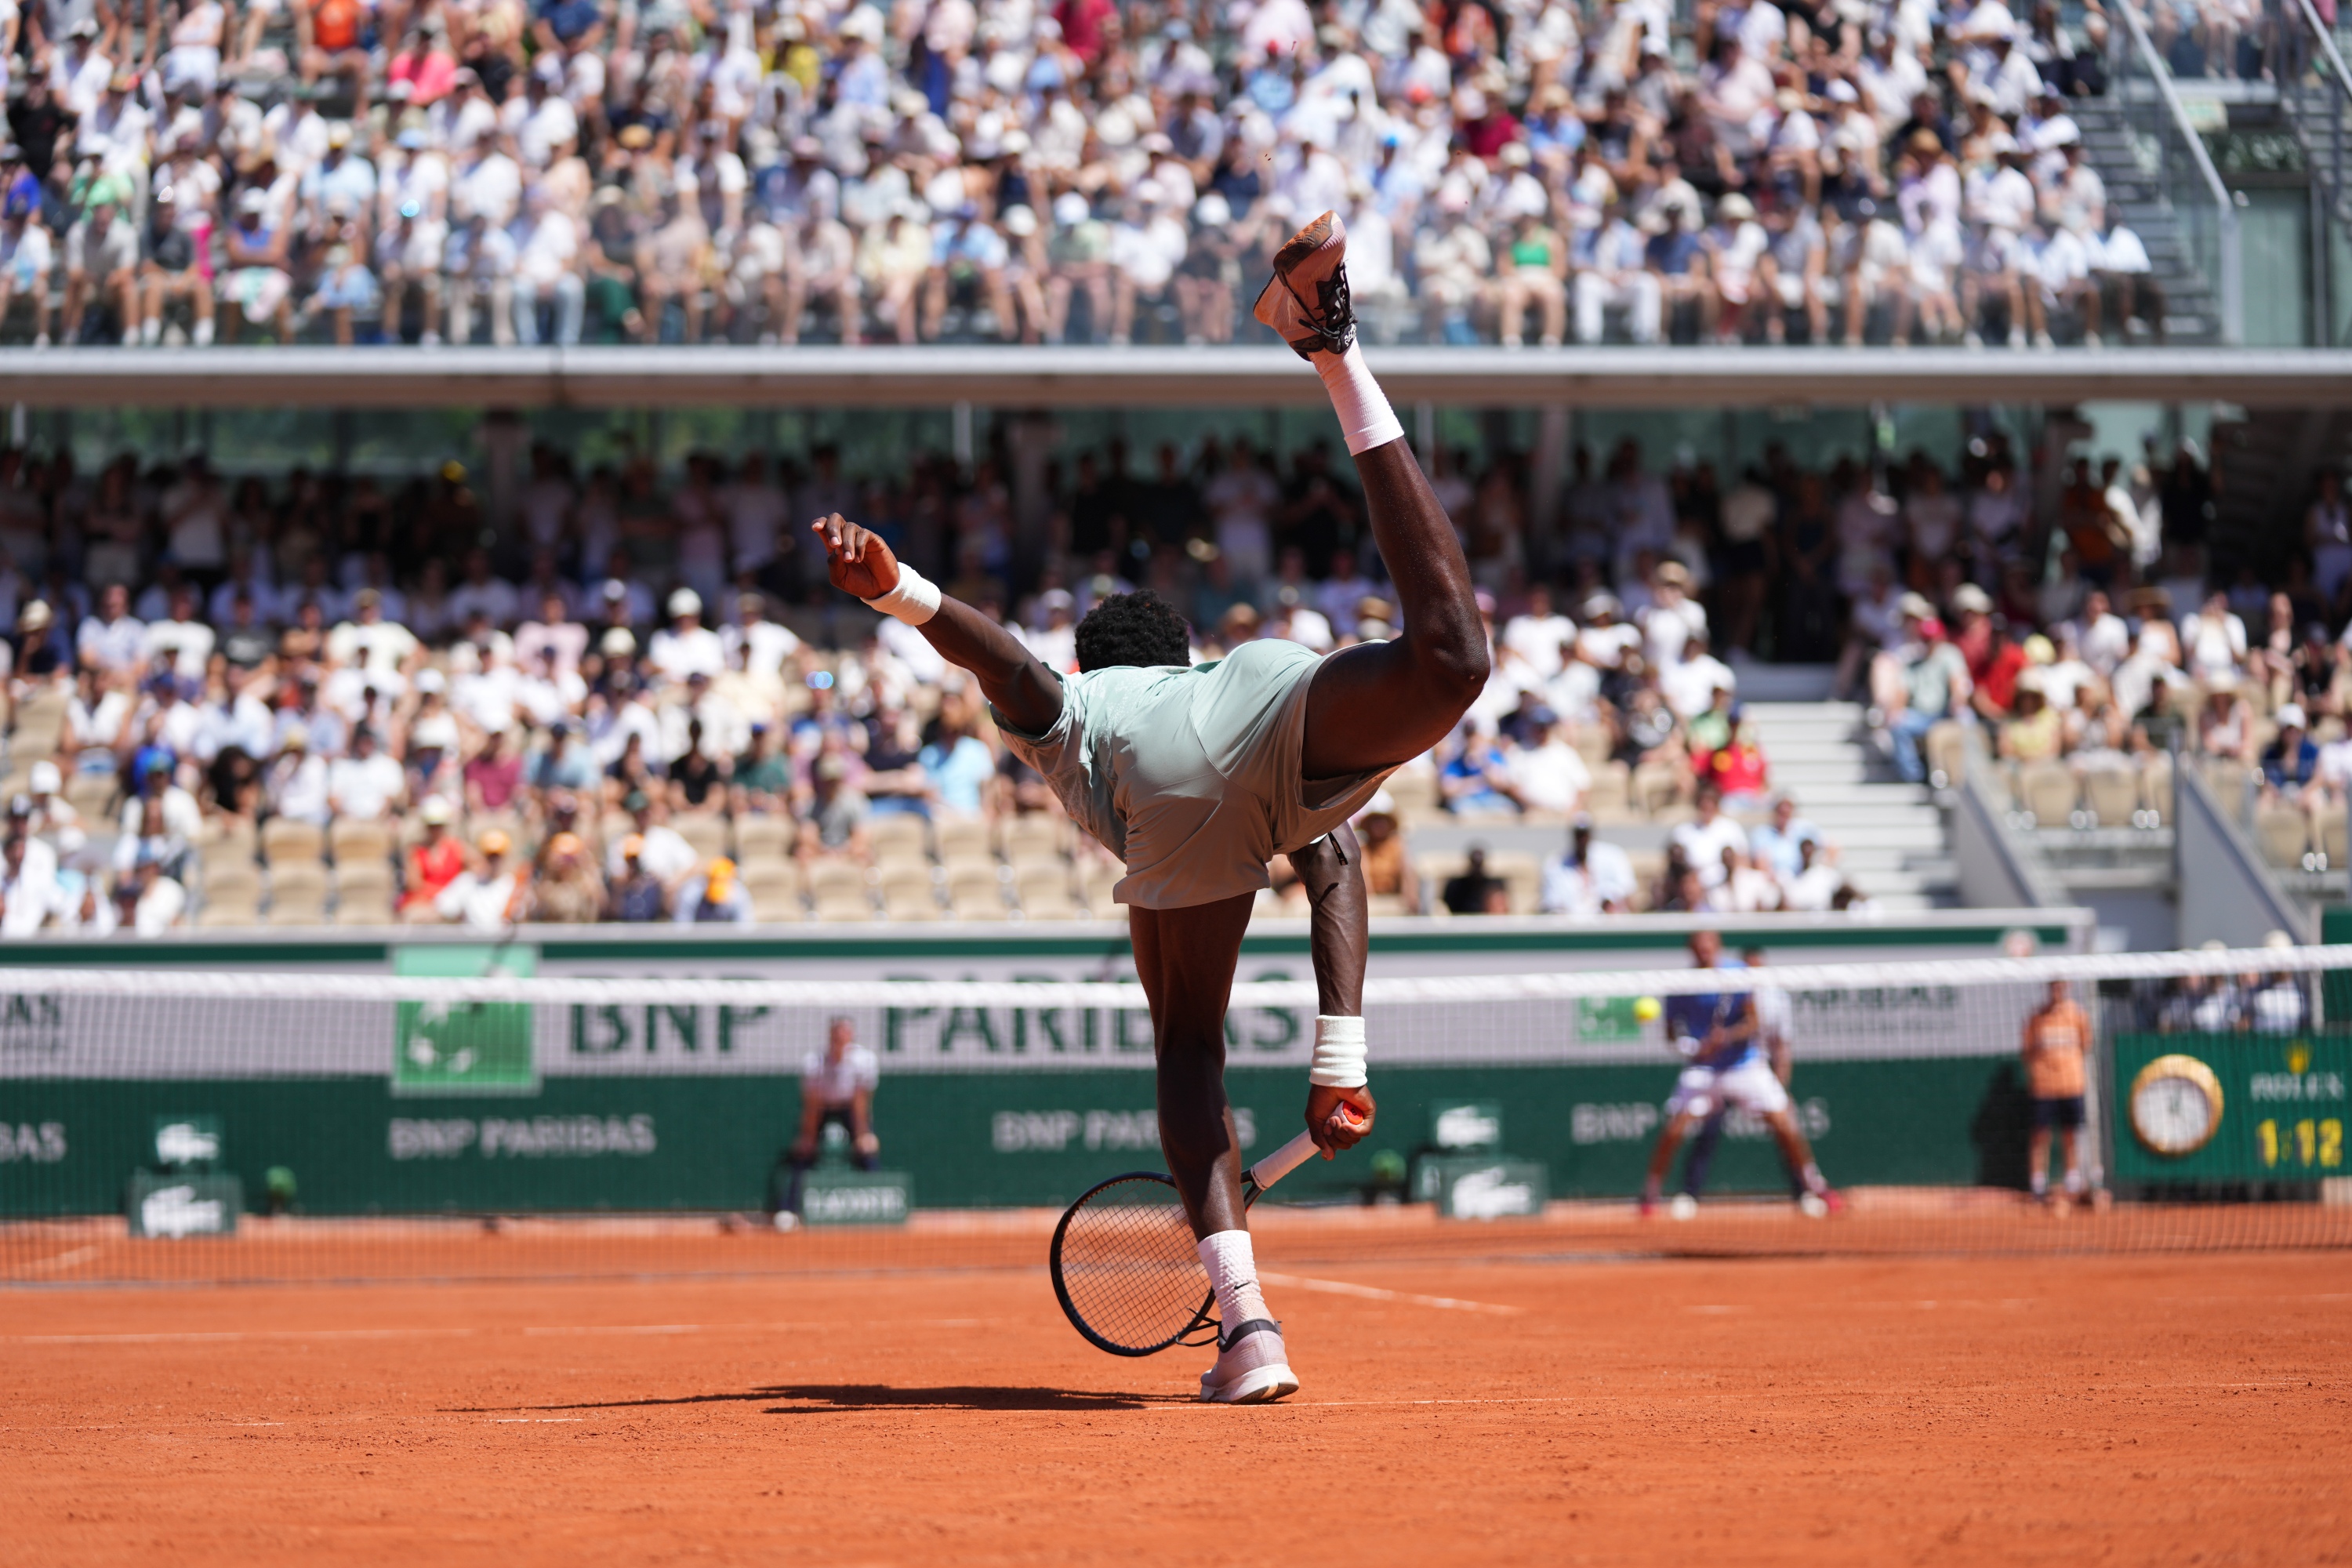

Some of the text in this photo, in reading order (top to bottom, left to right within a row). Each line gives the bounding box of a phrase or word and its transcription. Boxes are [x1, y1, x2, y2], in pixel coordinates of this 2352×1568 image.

[883, 972, 1297, 1052] PARIS
[390, 1114, 656, 1160] BNP PARIBAS
[992, 1109, 1255, 1151] BNP PARS
[1572, 1102, 1657, 1144] BNP
